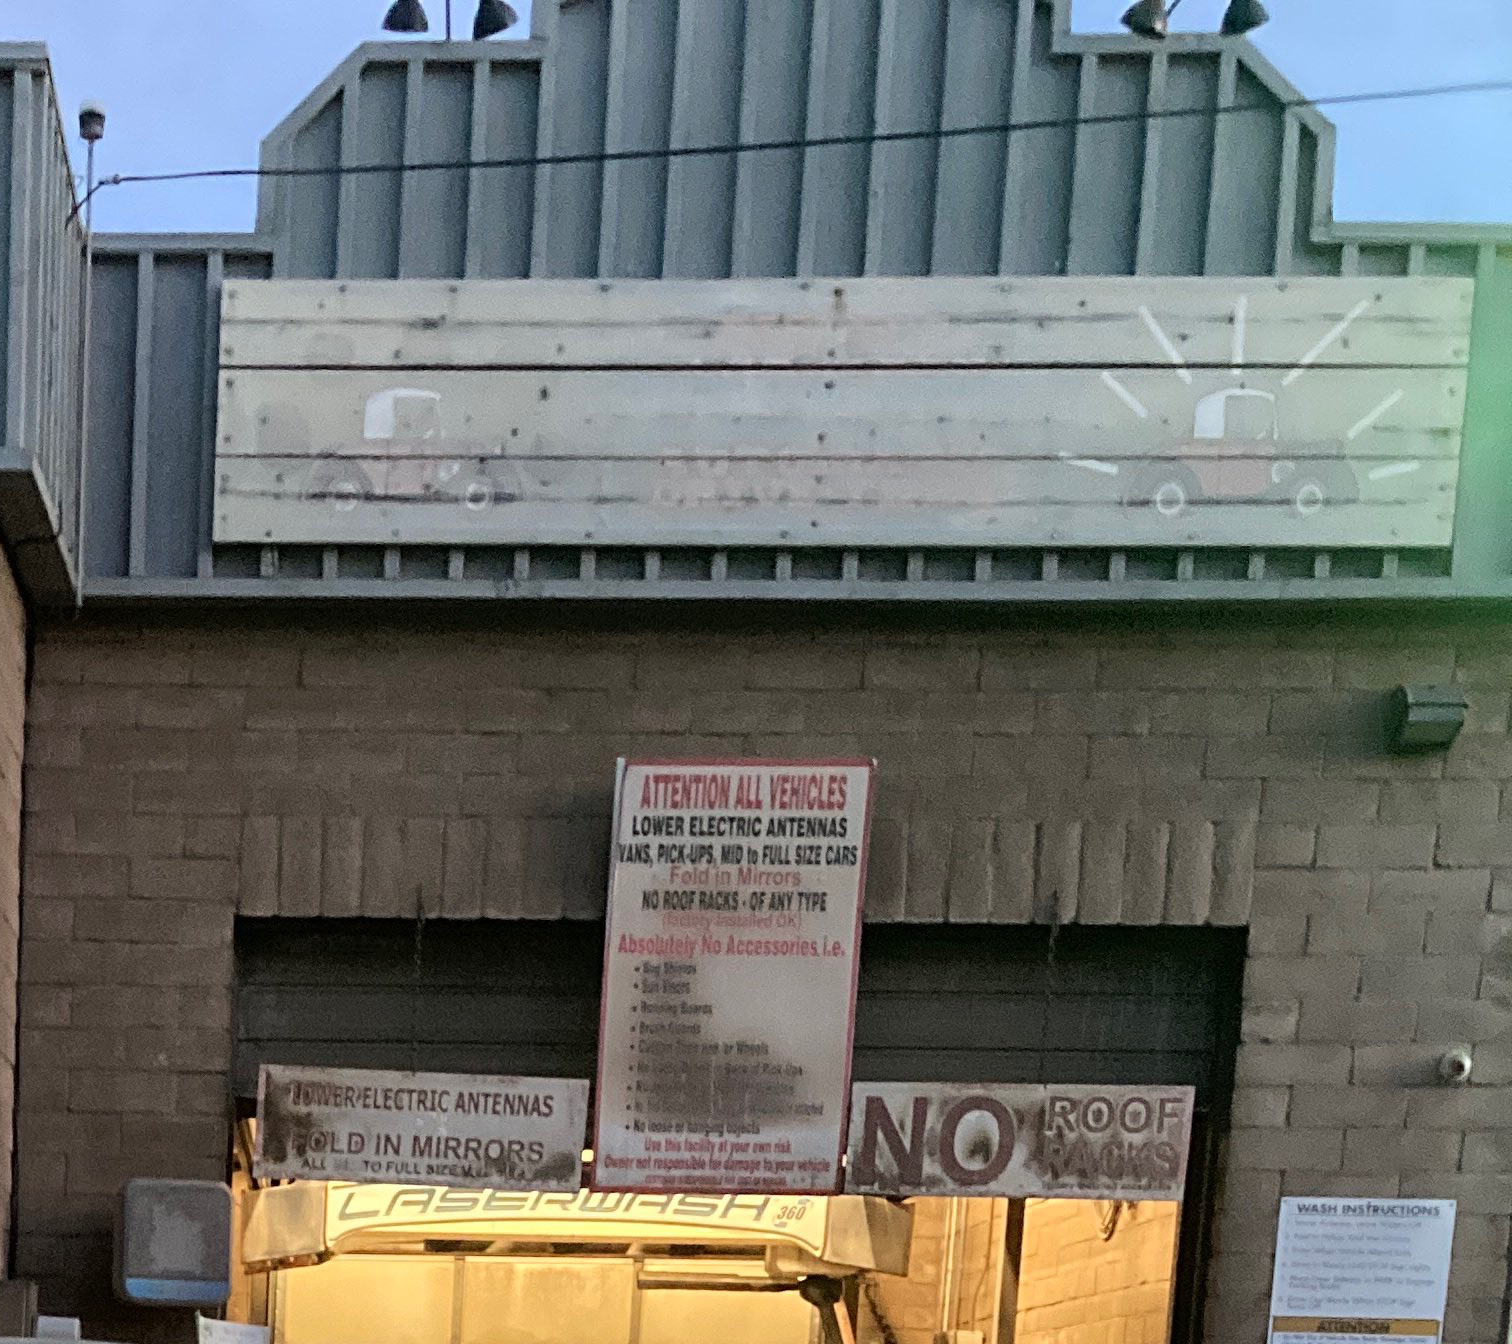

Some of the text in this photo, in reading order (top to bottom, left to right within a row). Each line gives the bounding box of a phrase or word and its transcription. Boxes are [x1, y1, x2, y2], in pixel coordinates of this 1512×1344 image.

[640, 774, 848, 810] ATTENTION ALL VEHICLES
[632, 815, 848, 838] LOWER ELECTRIC ANTENNAS
[720, 844, 744, 865] MID
[747, 845, 758, 865] to
[762, 845, 791, 865] FULL
[794, 845, 822, 865] SIZE
[825, 845, 858, 866] CARS
[669, 866, 802, 887] Fold in Mirrors
[642, 889, 660, 911] NO
[663, 890, 697, 911] ROOF
[699, 890, 738, 911] RACKS
[749, 891, 767, 912] OF
[768, 891, 794, 912] ANY
[797, 892, 828, 912] TYPE
[618, 933, 698, 958] Absolutely
[702, 935, 722, 955] No
[360, 1088, 450, 1113] ELECTRIC
[454, 1092, 554, 1118] ANTENNAS
[1045, 1095, 1184, 1134] ROOF
[375, 1132, 401, 1156] IN
[412, 1135, 544, 1162] MIRRORS
[852, 1095, 1016, 1186] NO
[300, 1158, 326, 1171] ALL
[363, 1160, 382, 1173] TO
[385, 1160, 421, 1175] FULL
[1044, 1140, 1181, 1180] RACKS
[338, 1187, 807, 1222] LASERWASH 360
[1297, 1203, 1441, 1217] WASH INSTRUCTIONS
